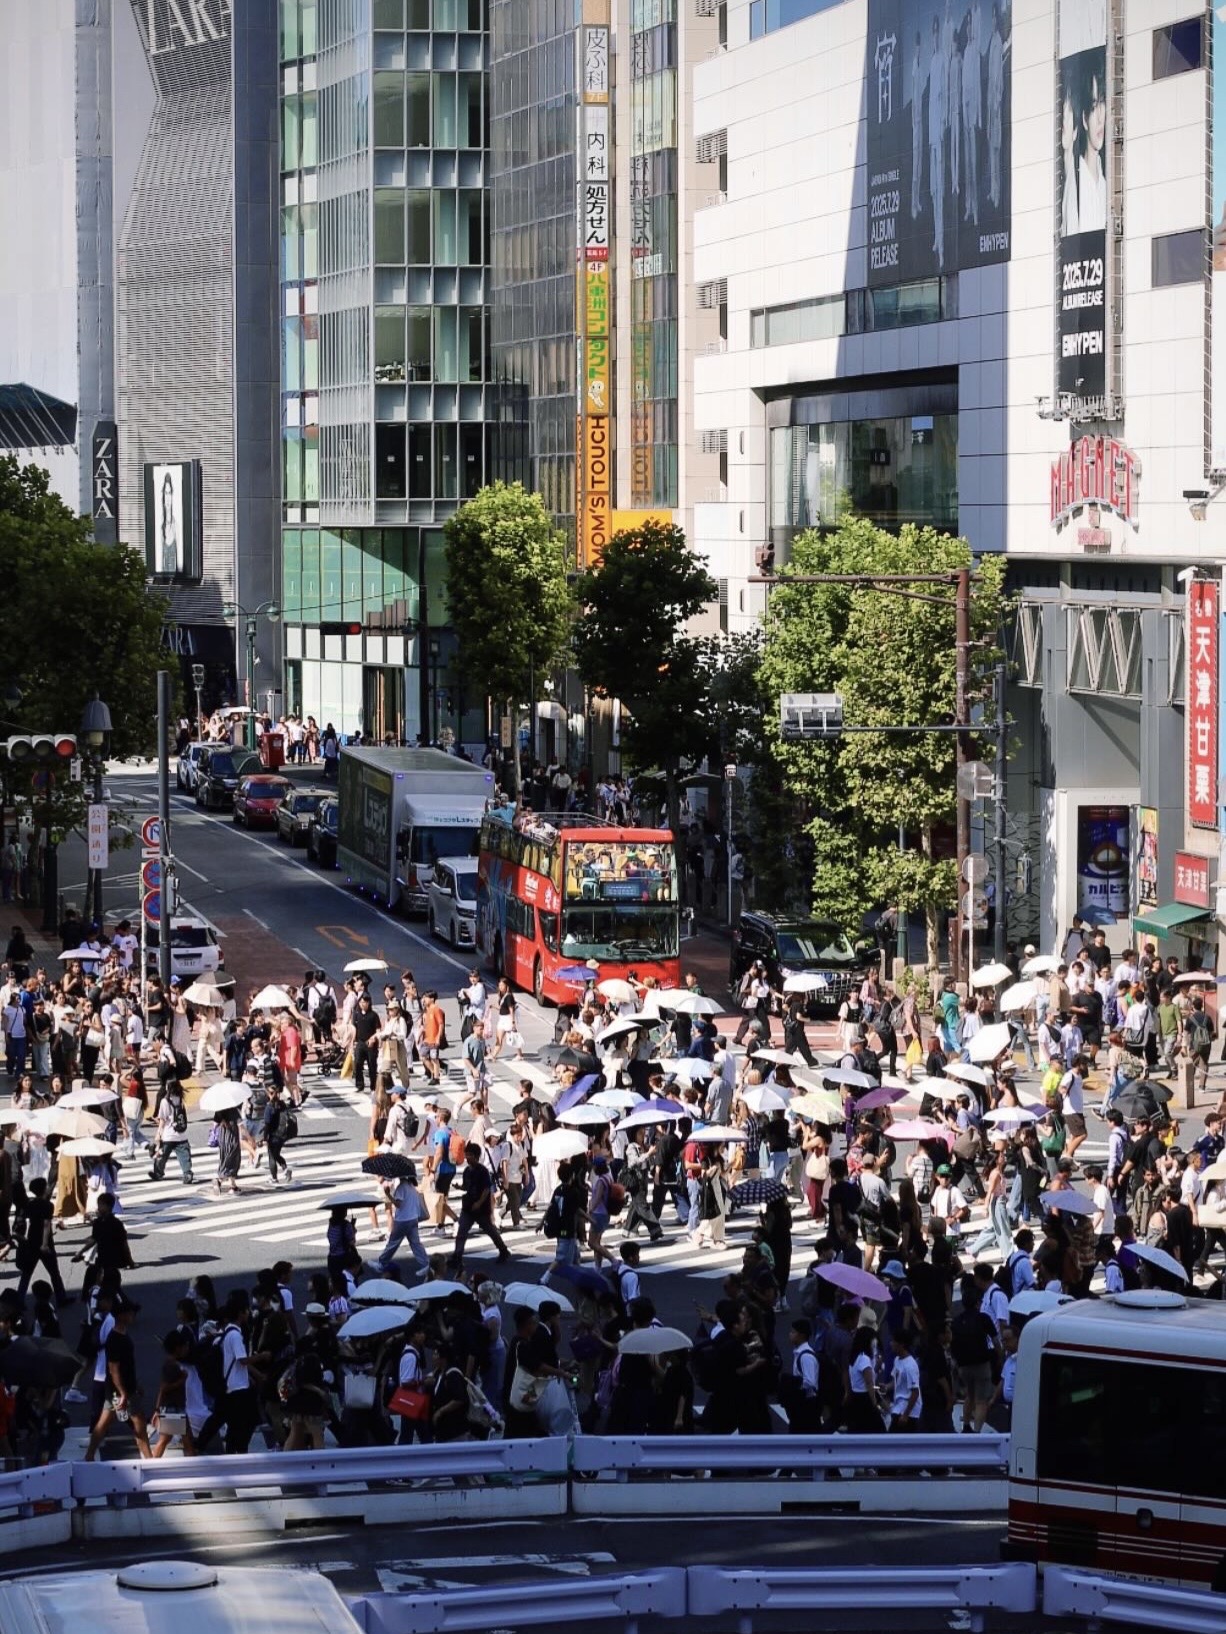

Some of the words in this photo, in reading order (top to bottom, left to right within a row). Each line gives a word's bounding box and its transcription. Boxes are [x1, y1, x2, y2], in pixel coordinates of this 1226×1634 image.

[586, 29, 606, 90] 皮ふ科
[587, 132, 605, 174] 内科
[586, 185, 606, 244] 処方せん
[871, 190, 899, 218] 2025.7.29
[871, 217, 896, 244] ALBUM
[980, 231, 1008, 253] ENHYPEN
[589, 262, 602, 272] 4F
[871, 243, 899, 270] RELEASE
[1062, 258, 1103, 291] 2025.7.29
[1080, 289, 1103, 307] RELEASE
[1062, 330, 1103, 358] ENHYPEN
[590, 415, 606, 489] TOUCH
[94, 437, 115, 519] ZARA
[1050, 436, 1135, 522] MAGNET
[589, 496, 605, 566] MOM'S
[1195, 626, 1212, 804] 天津甘栗
[1177, 866, 1207, 893] 天津甘栗
